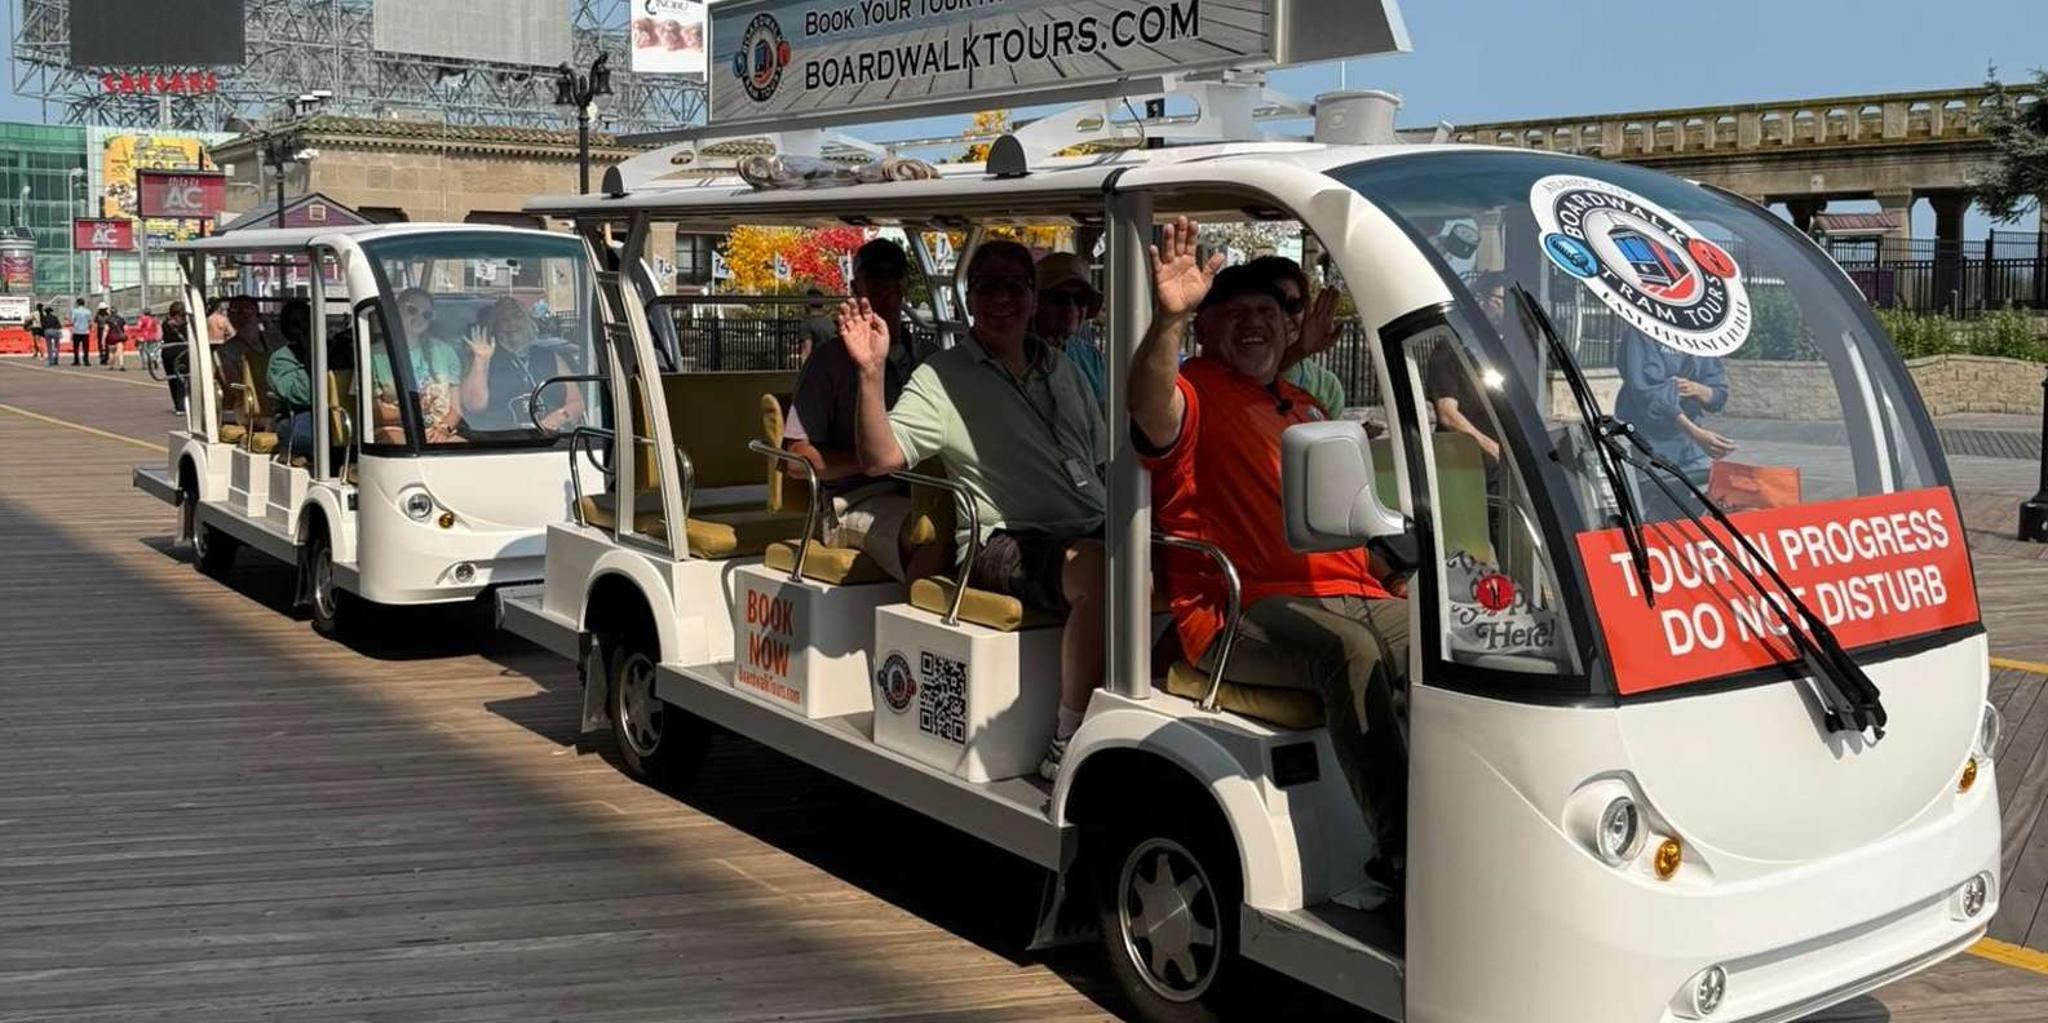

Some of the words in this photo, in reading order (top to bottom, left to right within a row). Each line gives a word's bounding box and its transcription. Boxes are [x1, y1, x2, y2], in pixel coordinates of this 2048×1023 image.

[806, 0, 1198, 90] BOARDWALKTOURS.COM
[165, 187, 203, 208] AC
[1560, 190, 1686, 241] BOARDWALK
[92, 229, 117, 244] AC
[1601, 265, 1678, 324] TRAM
[1684, 274, 1722, 327] TOURS
[1610, 539, 1733, 597] TOUR
[1733, 532, 1779, 577] IN
[1778, 507, 1949, 571] PROGRESS
[748, 589, 793, 636] BOOK
[1661, 602, 1726, 656] DO
[1815, 564, 1947, 626] DISTURB
[749, 631, 790, 677] NOW
[1475, 620, 1556, 650] Here!
